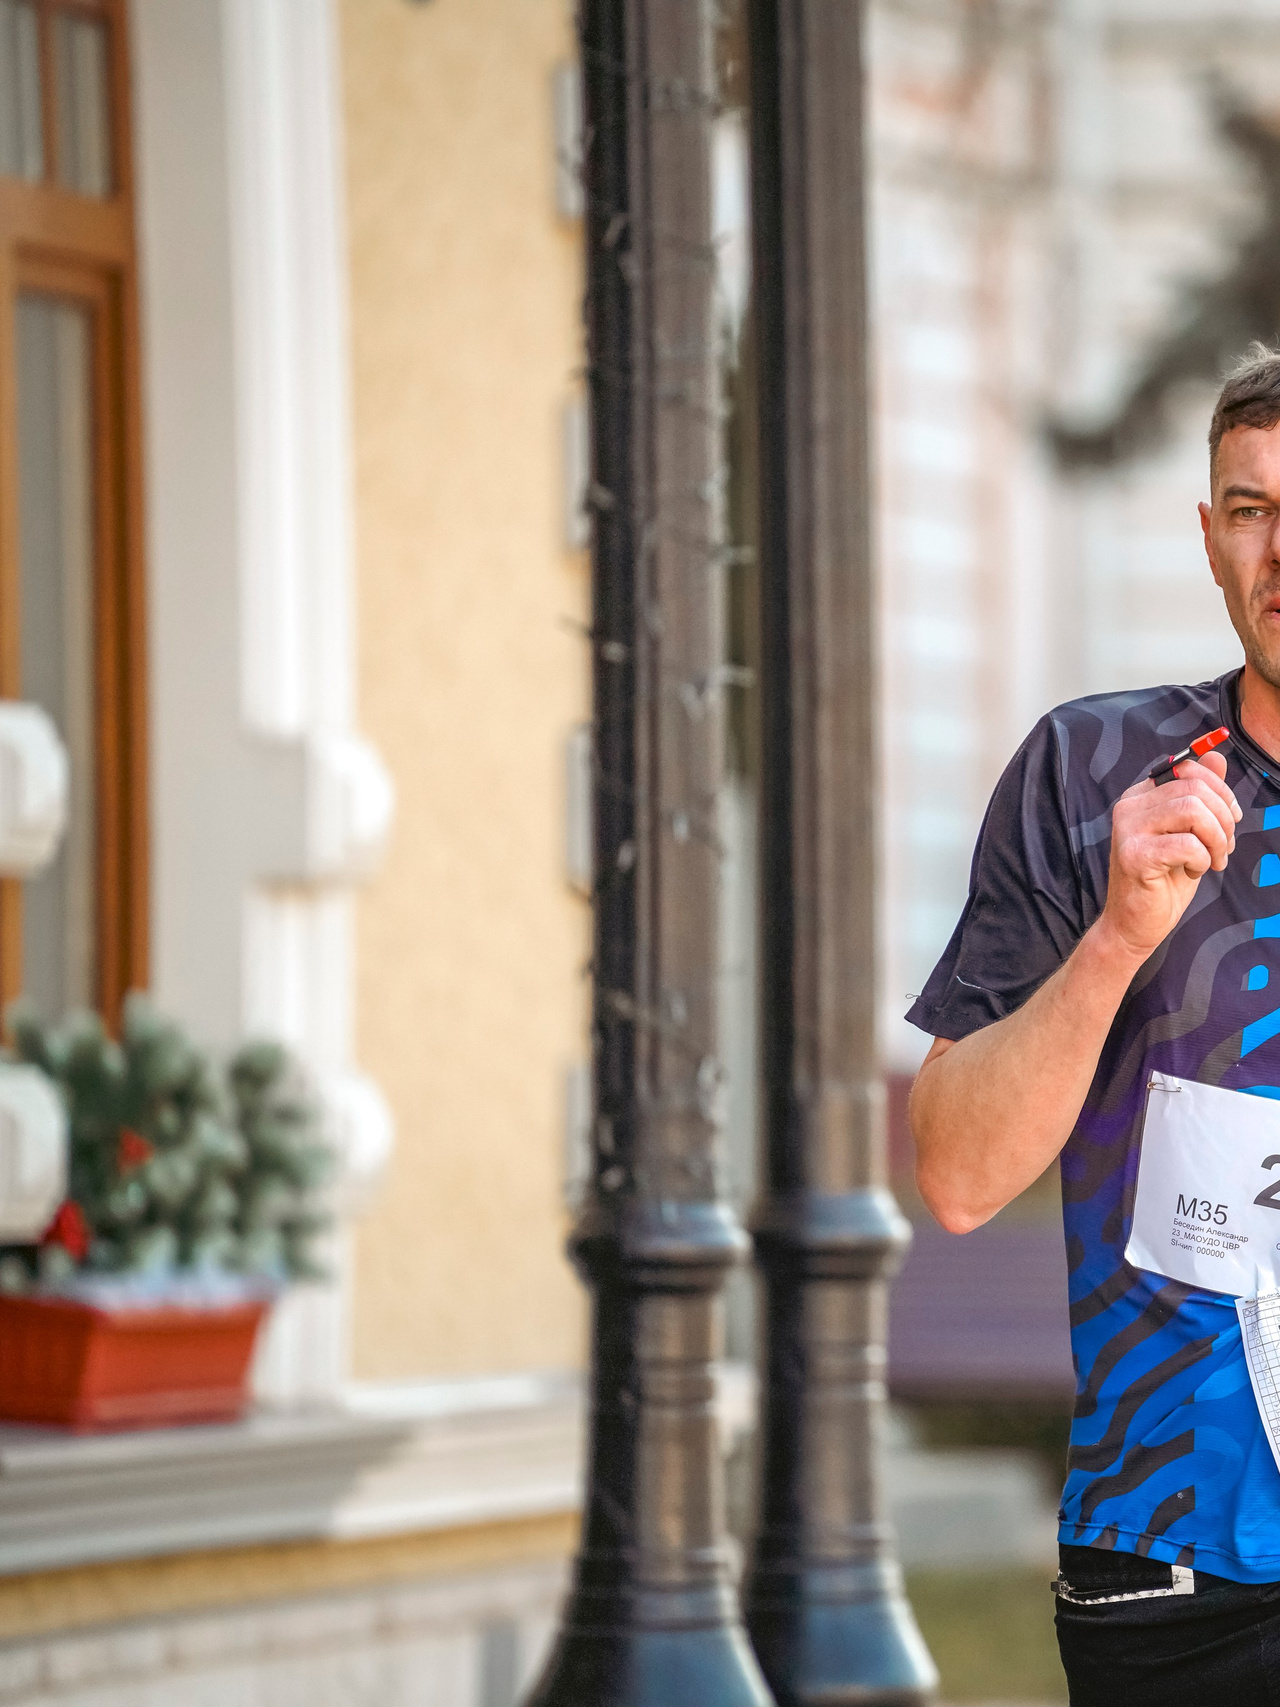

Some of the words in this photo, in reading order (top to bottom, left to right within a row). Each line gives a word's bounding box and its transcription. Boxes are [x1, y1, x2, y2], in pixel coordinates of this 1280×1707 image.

[1176, 1194, 1228, 1225] M35
[1172, 1228, 1220, 1247] 23_МАОУДО
[1223, 1240, 1240, 1250] ЦВР
[1173, 1218, 1204, 1233] Беседин
[1207, 1228, 1248, 1243] Александр
[1196, 1247, 1225, 1259] 000000
